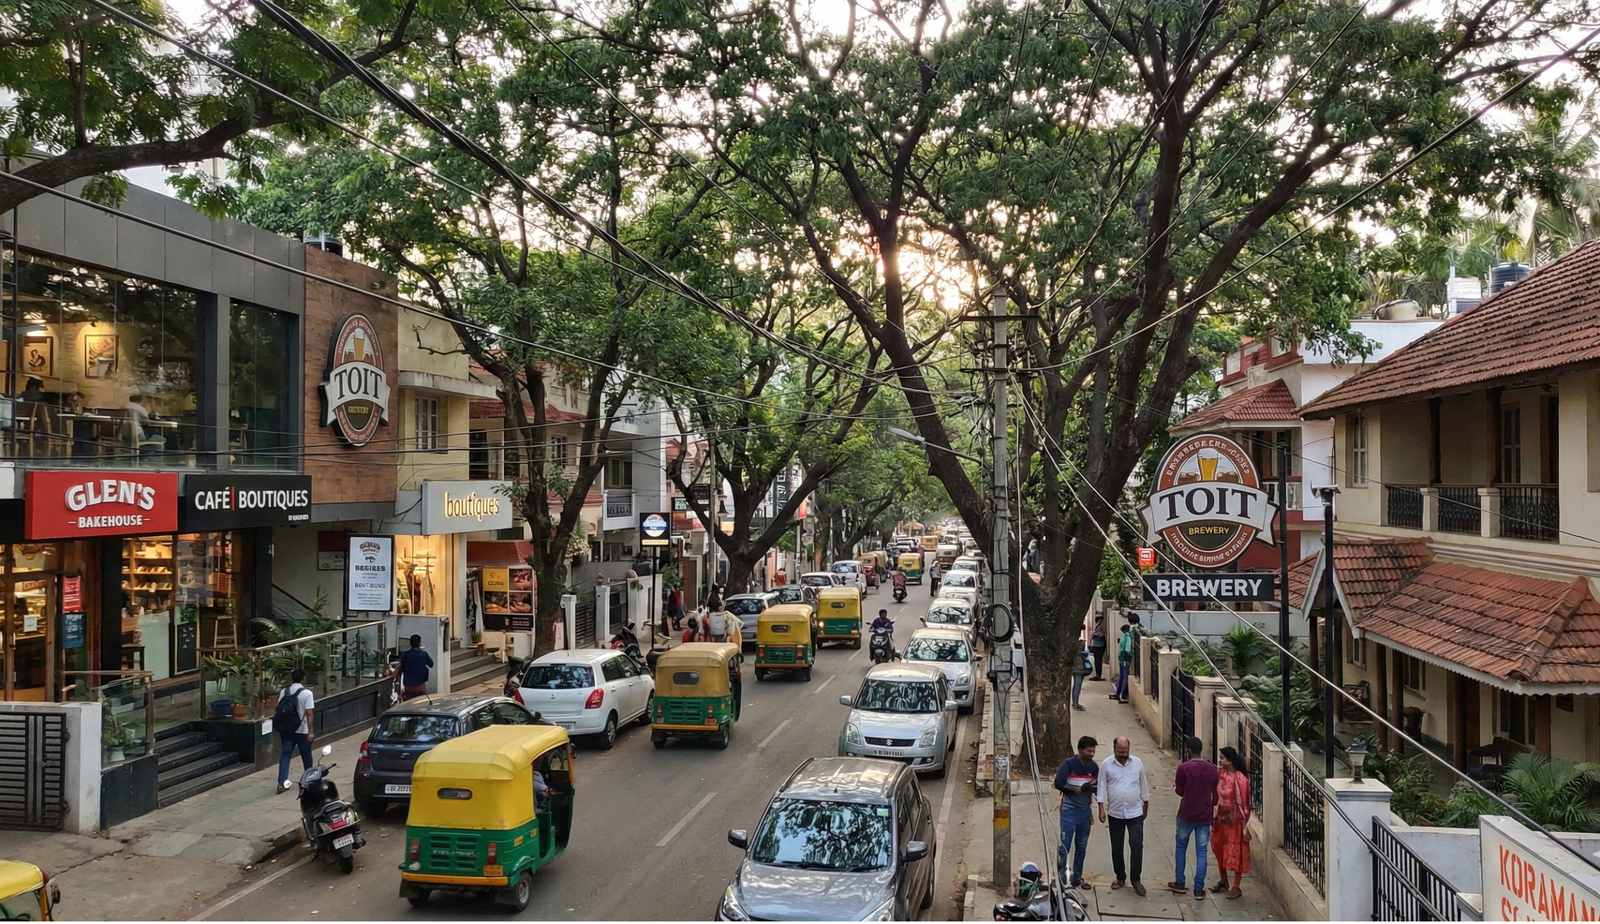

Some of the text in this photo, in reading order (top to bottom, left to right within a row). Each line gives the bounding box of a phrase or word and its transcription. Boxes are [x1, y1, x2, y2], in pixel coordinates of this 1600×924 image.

[334, 367, 382, 400] TOIT
[65, 479, 156, 512] GLEN'S
[195, 486, 308, 510] CAFÉ BOUTIQUES
[444, 491, 500, 522] boutiques
[1159, 487, 1258, 522] TOIT
[78, 515, 143, 528] BAKEHOUSE
[1188, 526, 1230, 536] BREWERY
[1156, 579, 1263, 597] BREWERY
